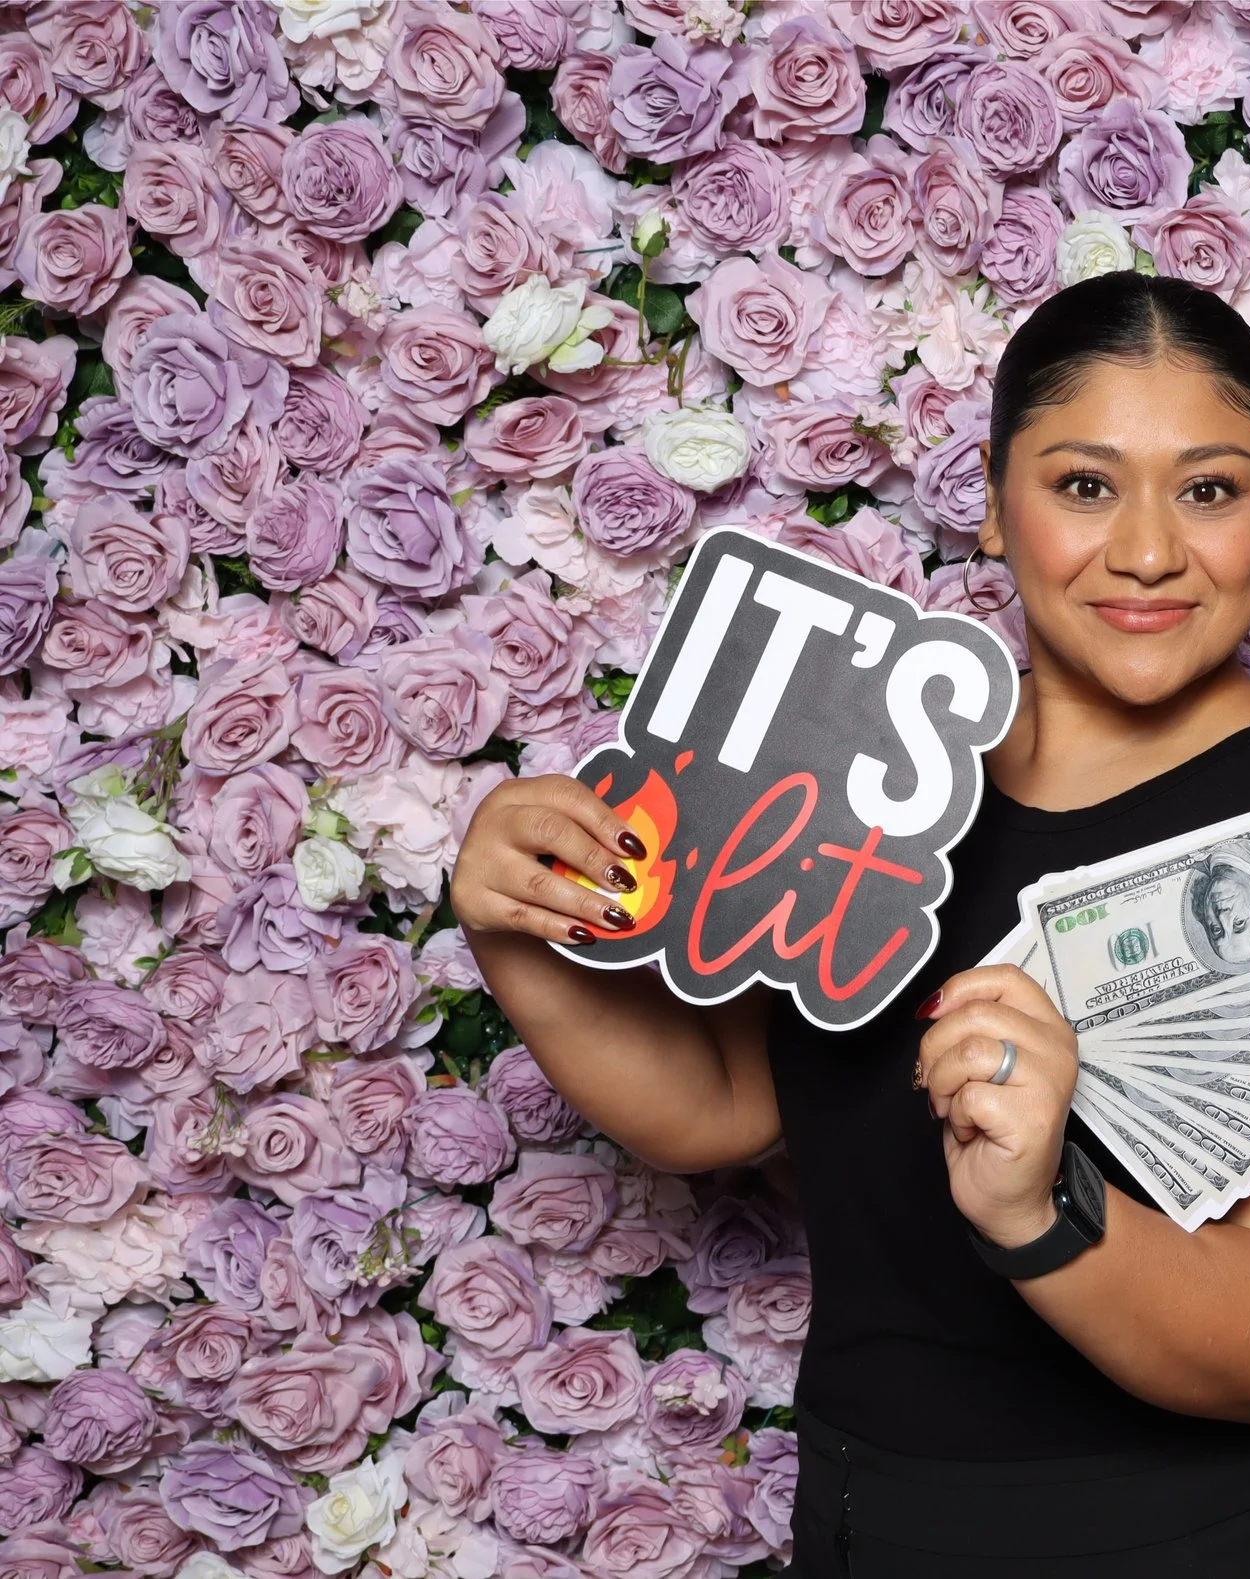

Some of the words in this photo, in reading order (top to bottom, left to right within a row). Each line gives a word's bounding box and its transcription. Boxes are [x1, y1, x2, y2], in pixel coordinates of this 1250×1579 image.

[646, 553, 990, 837] IT'S
[1107, 867, 1169, 895] HUNDRED
[1169, 858, 1195, 872] ONE
[688, 772, 923, 1001] lit
[1047, 889, 1106, 916] DOLLARS
[1055, 903, 1110, 933] 100
[1075, 998, 1154, 1032] 100
[1178, 1122, 1240, 1165] 100
[1135, 1143, 1186, 1197] 100
